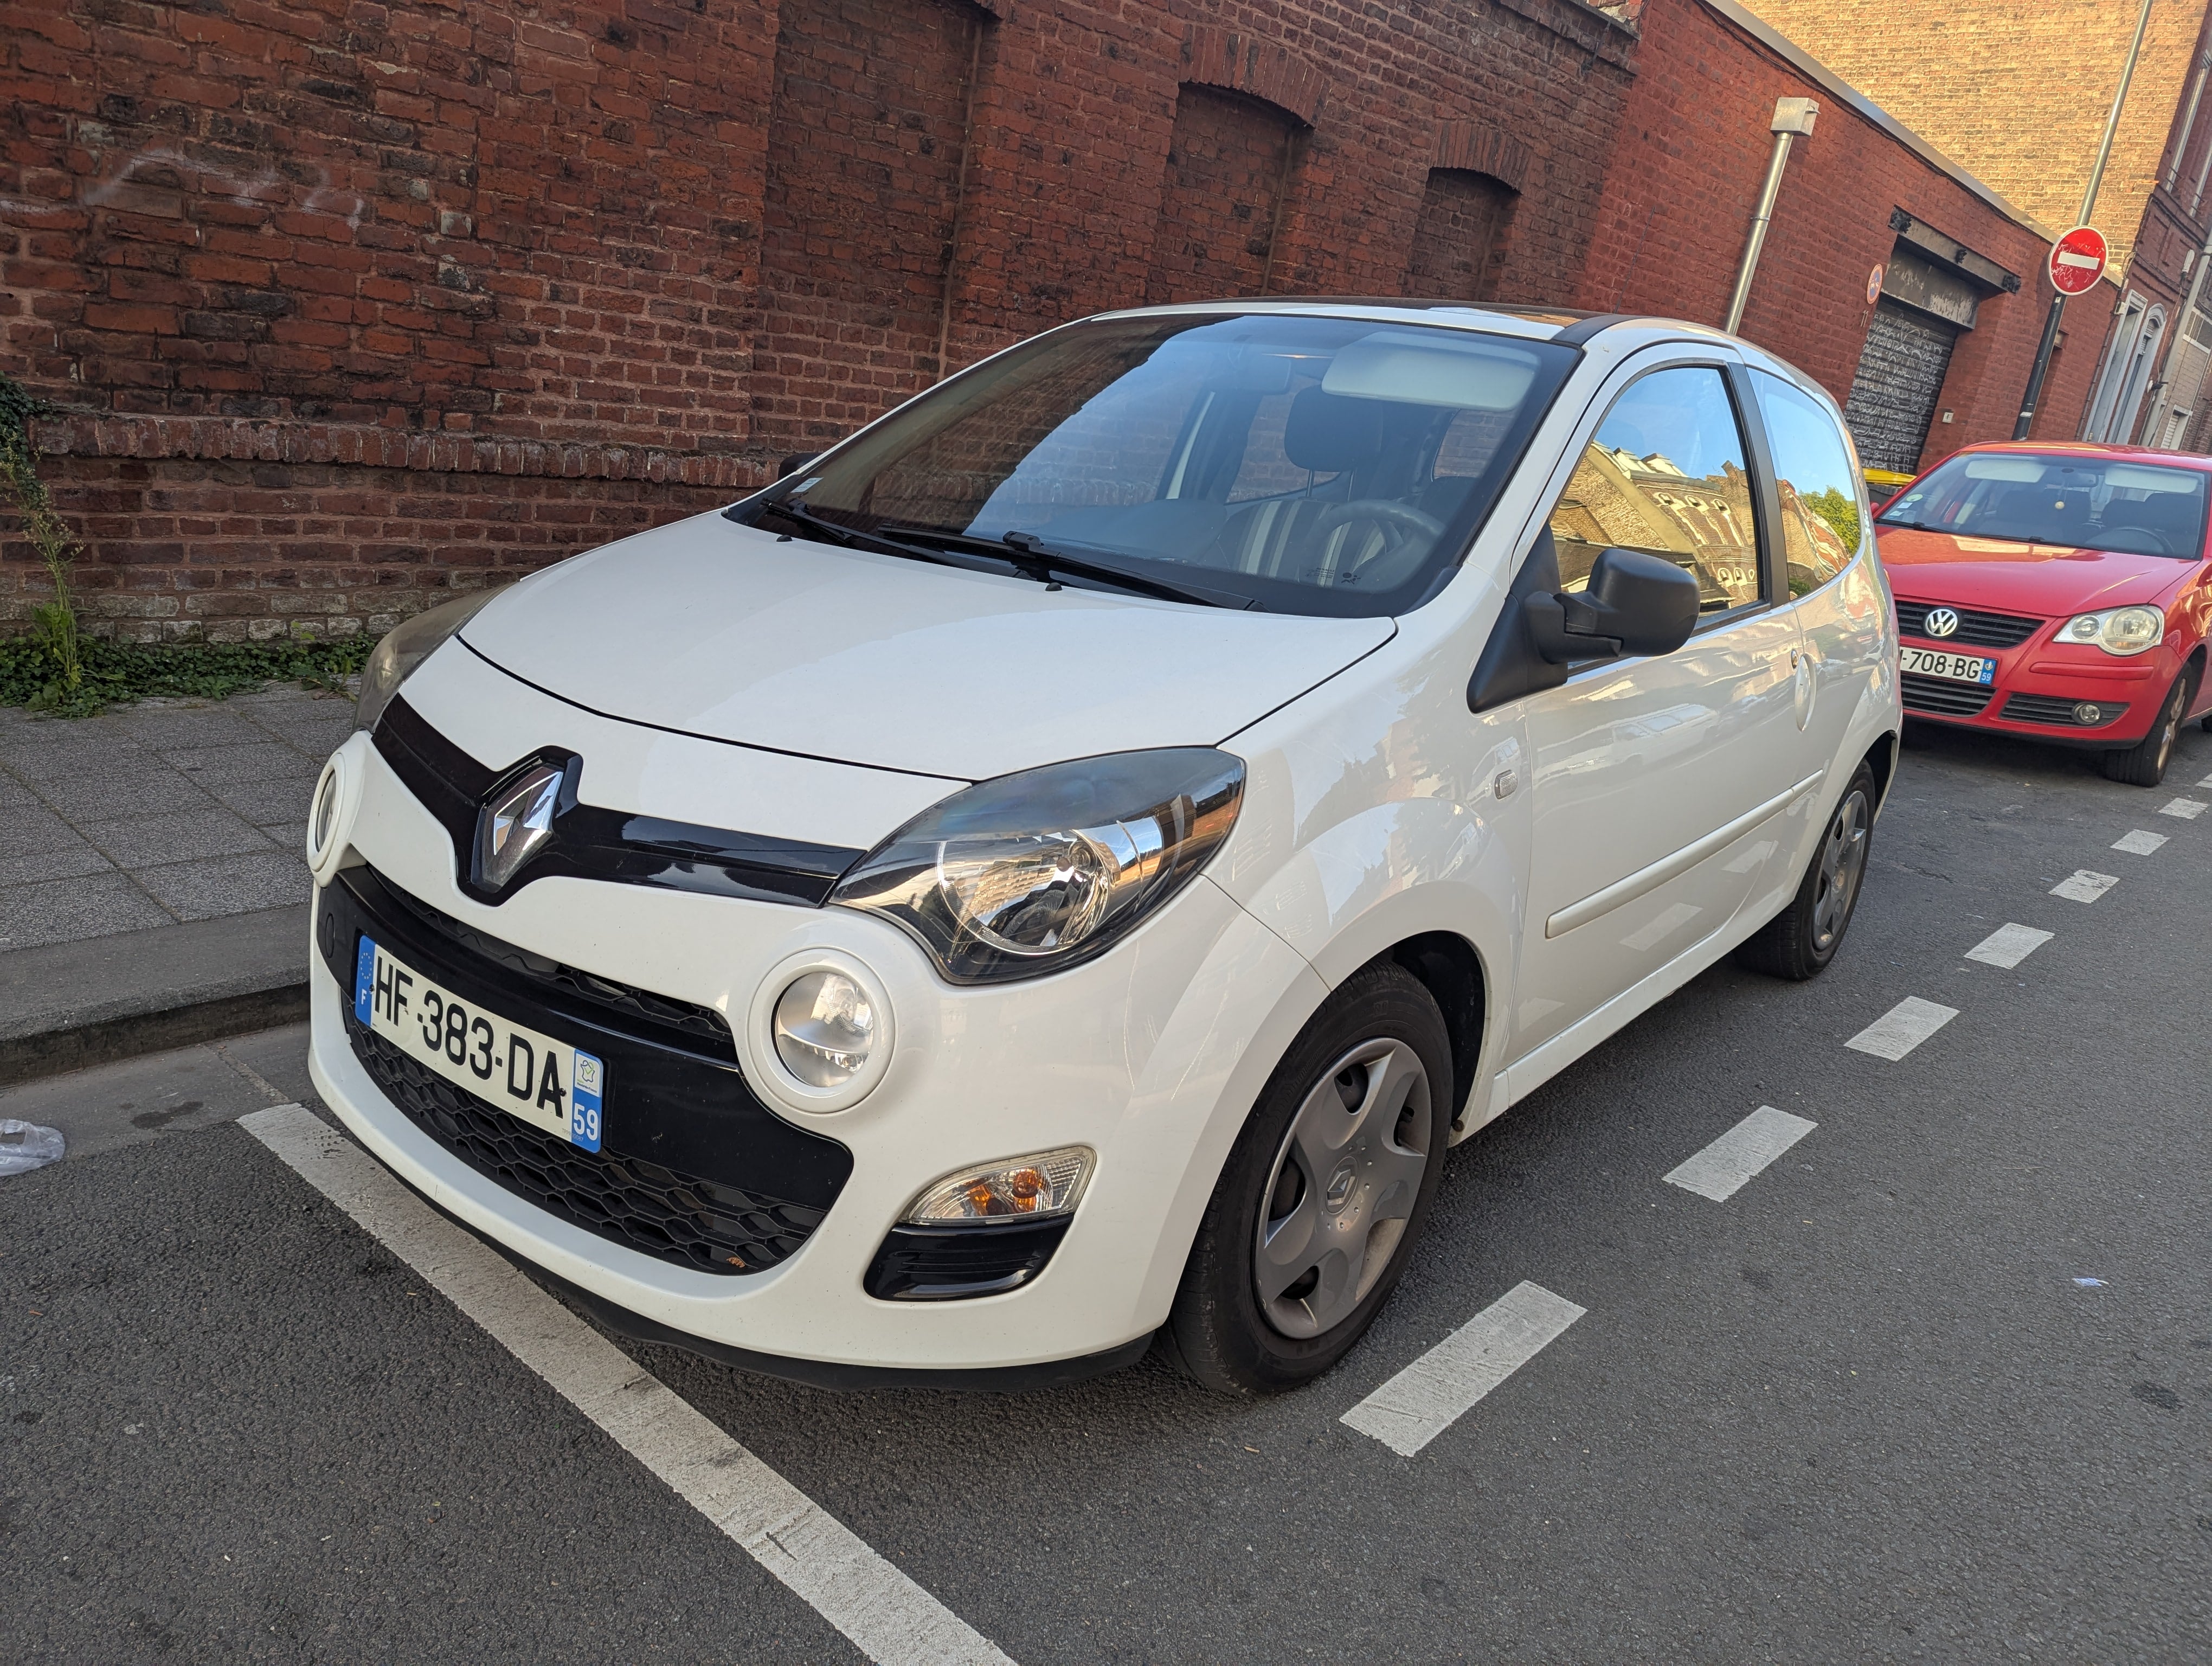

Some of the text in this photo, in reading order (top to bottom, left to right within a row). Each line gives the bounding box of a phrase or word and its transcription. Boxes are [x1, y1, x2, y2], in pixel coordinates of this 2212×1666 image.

[1982, 672, 1991, 682] 59
[361, 988, 367, 1005] F
[375, 956, 563, 1119] HF-383-DA
[574, 1103, 599, 1140] 59
